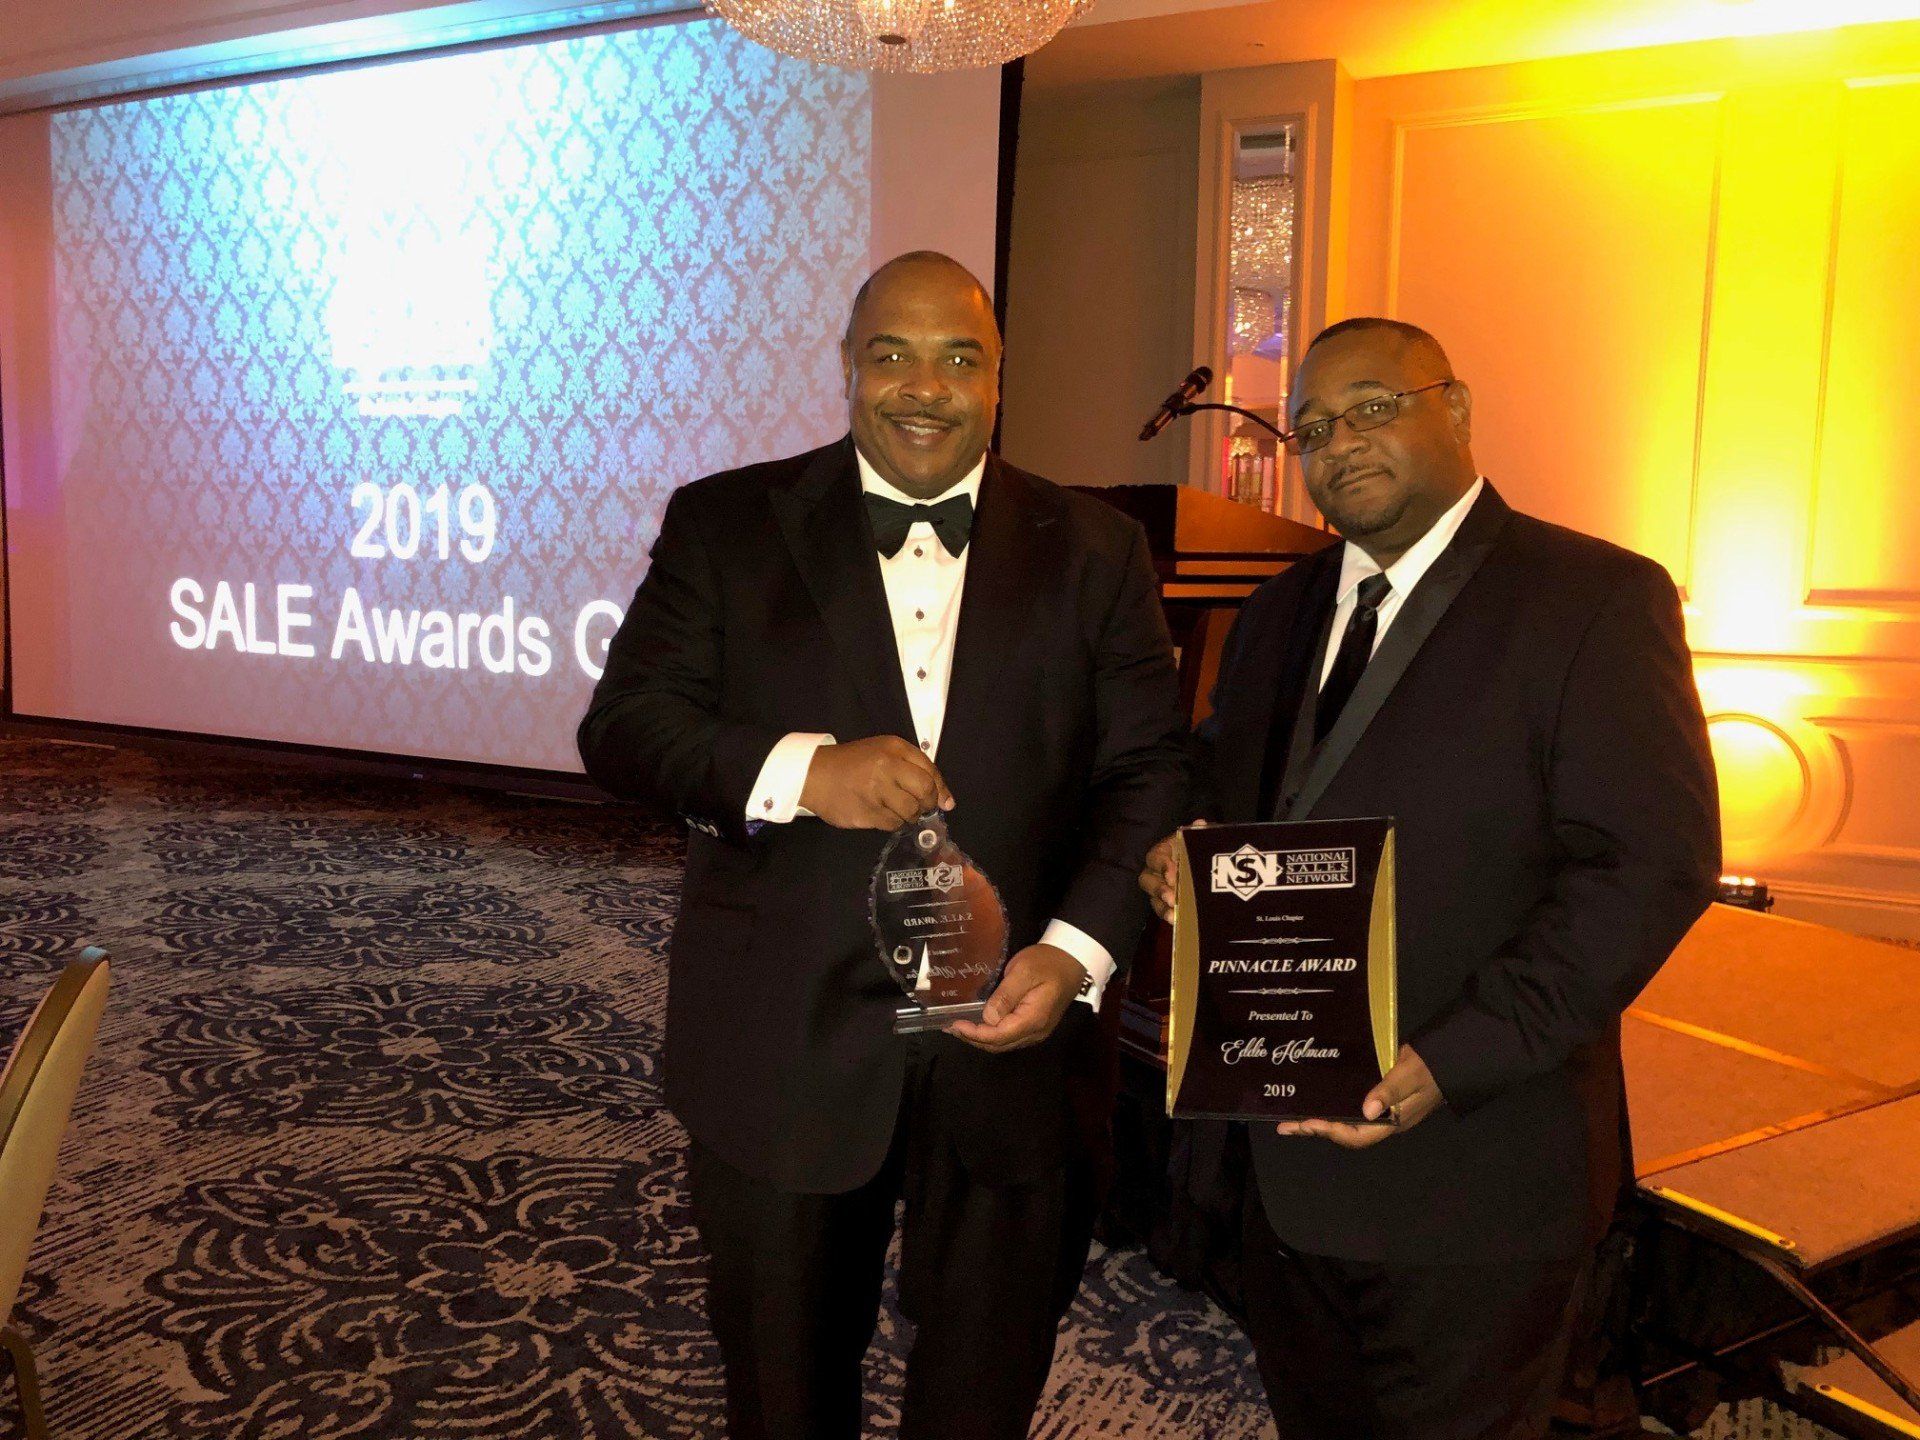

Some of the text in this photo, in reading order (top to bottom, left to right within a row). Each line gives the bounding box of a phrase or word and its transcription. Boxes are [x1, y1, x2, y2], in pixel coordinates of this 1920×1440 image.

[350, 482, 496, 563] 2019
[169, 577, 625, 681] SALE Awards G
[1286, 851, 1350, 863] NATIONAL
[1286, 862, 1349, 873] SALES
[1286, 873, 1350, 884] NETWORK
[1281, 914, 1304, 923] Chapter
[1208, 958, 1357, 974] PINNACLE AWARD
[1249, 1010, 1313, 1021] Presented To
[1221, 1037, 1340, 1065] Eddie Holman
[1263, 1084, 1296, 1097] 2019
